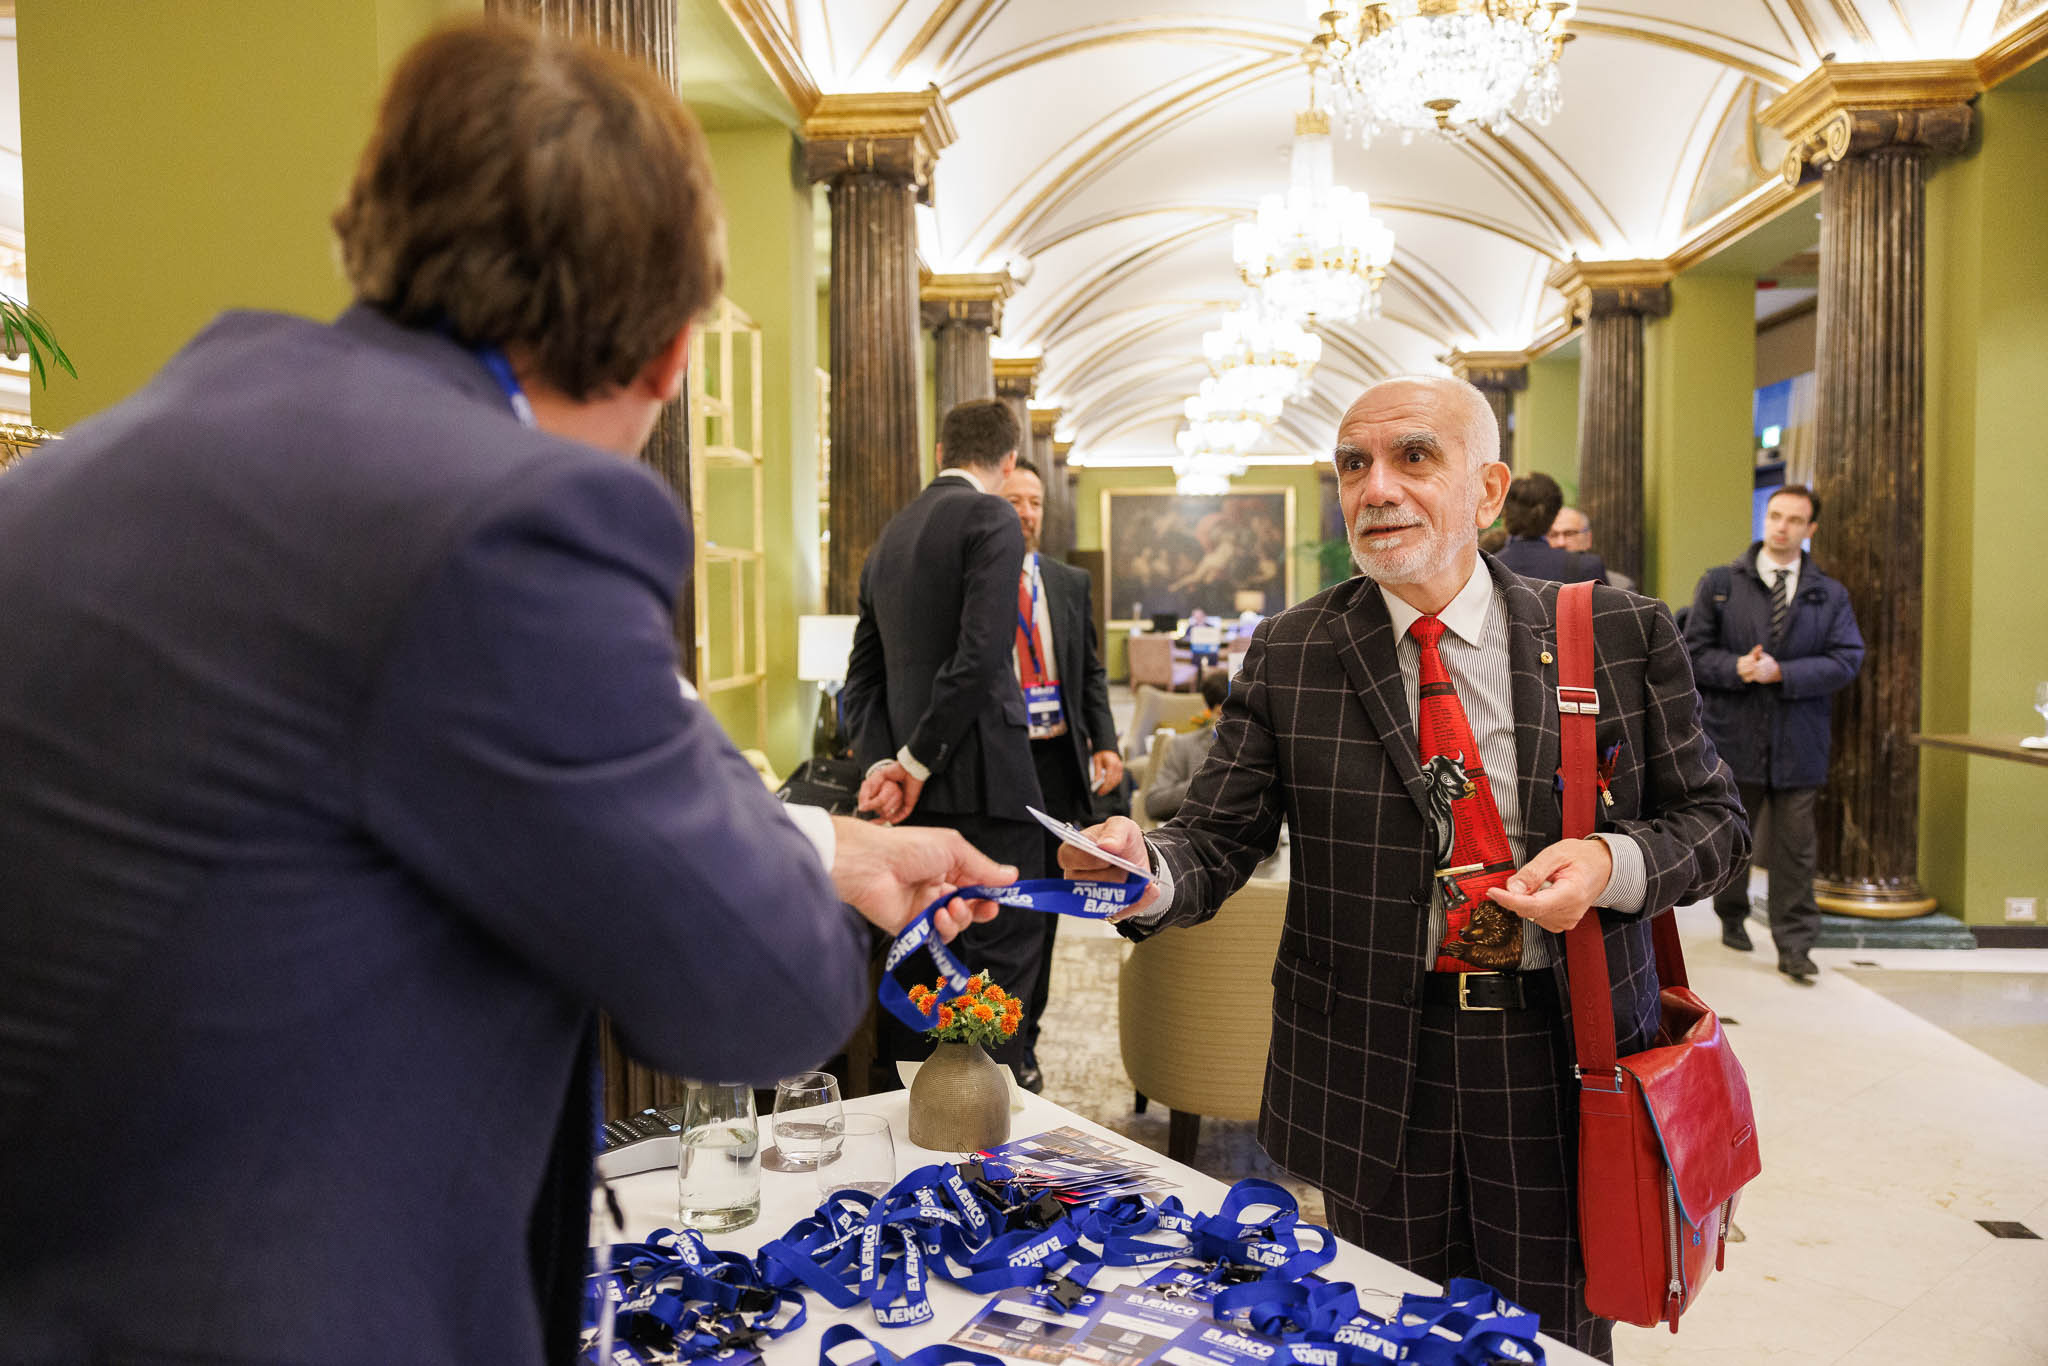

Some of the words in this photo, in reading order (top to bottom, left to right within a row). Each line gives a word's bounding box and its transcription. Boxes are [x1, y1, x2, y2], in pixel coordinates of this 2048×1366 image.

[948, 1174, 986, 1227] EVENCO
[860, 1224, 877, 1282] EVENCO
[1135, 1245, 1194, 1263] EVENCO
[875, 1299, 931, 1324] EVENCO
[1125, 1293, 1200, 1317] EVENCO
[1201, 1327, 1276, 1359] EVENCO
[1333, 1329, 1399, 1361] EVENCO
